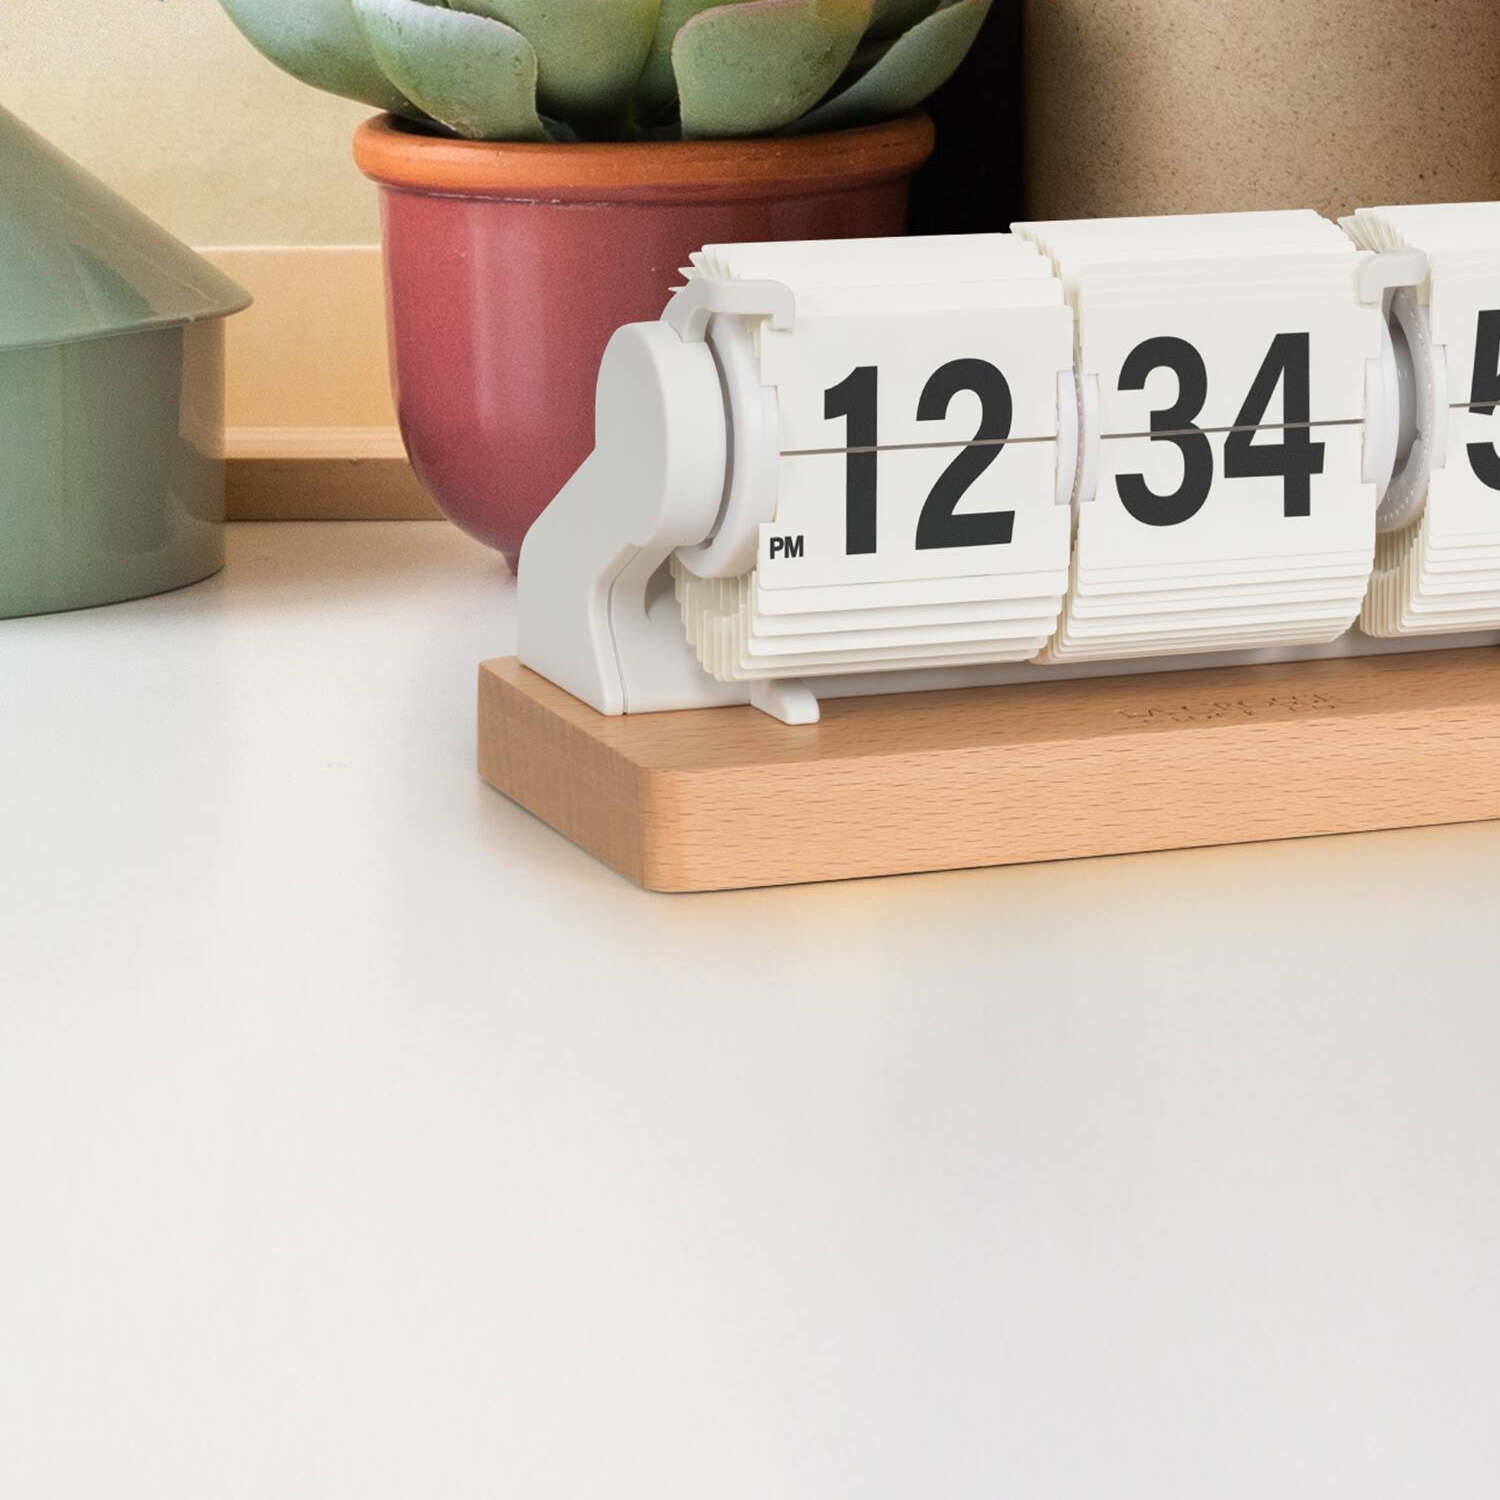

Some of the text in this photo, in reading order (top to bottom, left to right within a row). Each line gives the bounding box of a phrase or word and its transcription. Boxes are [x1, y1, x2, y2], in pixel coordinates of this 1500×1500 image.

[823, 358, 1016, 556] 12
[1114, 331, 1326, 527] 34
[769, 535, 804, 560] PM
